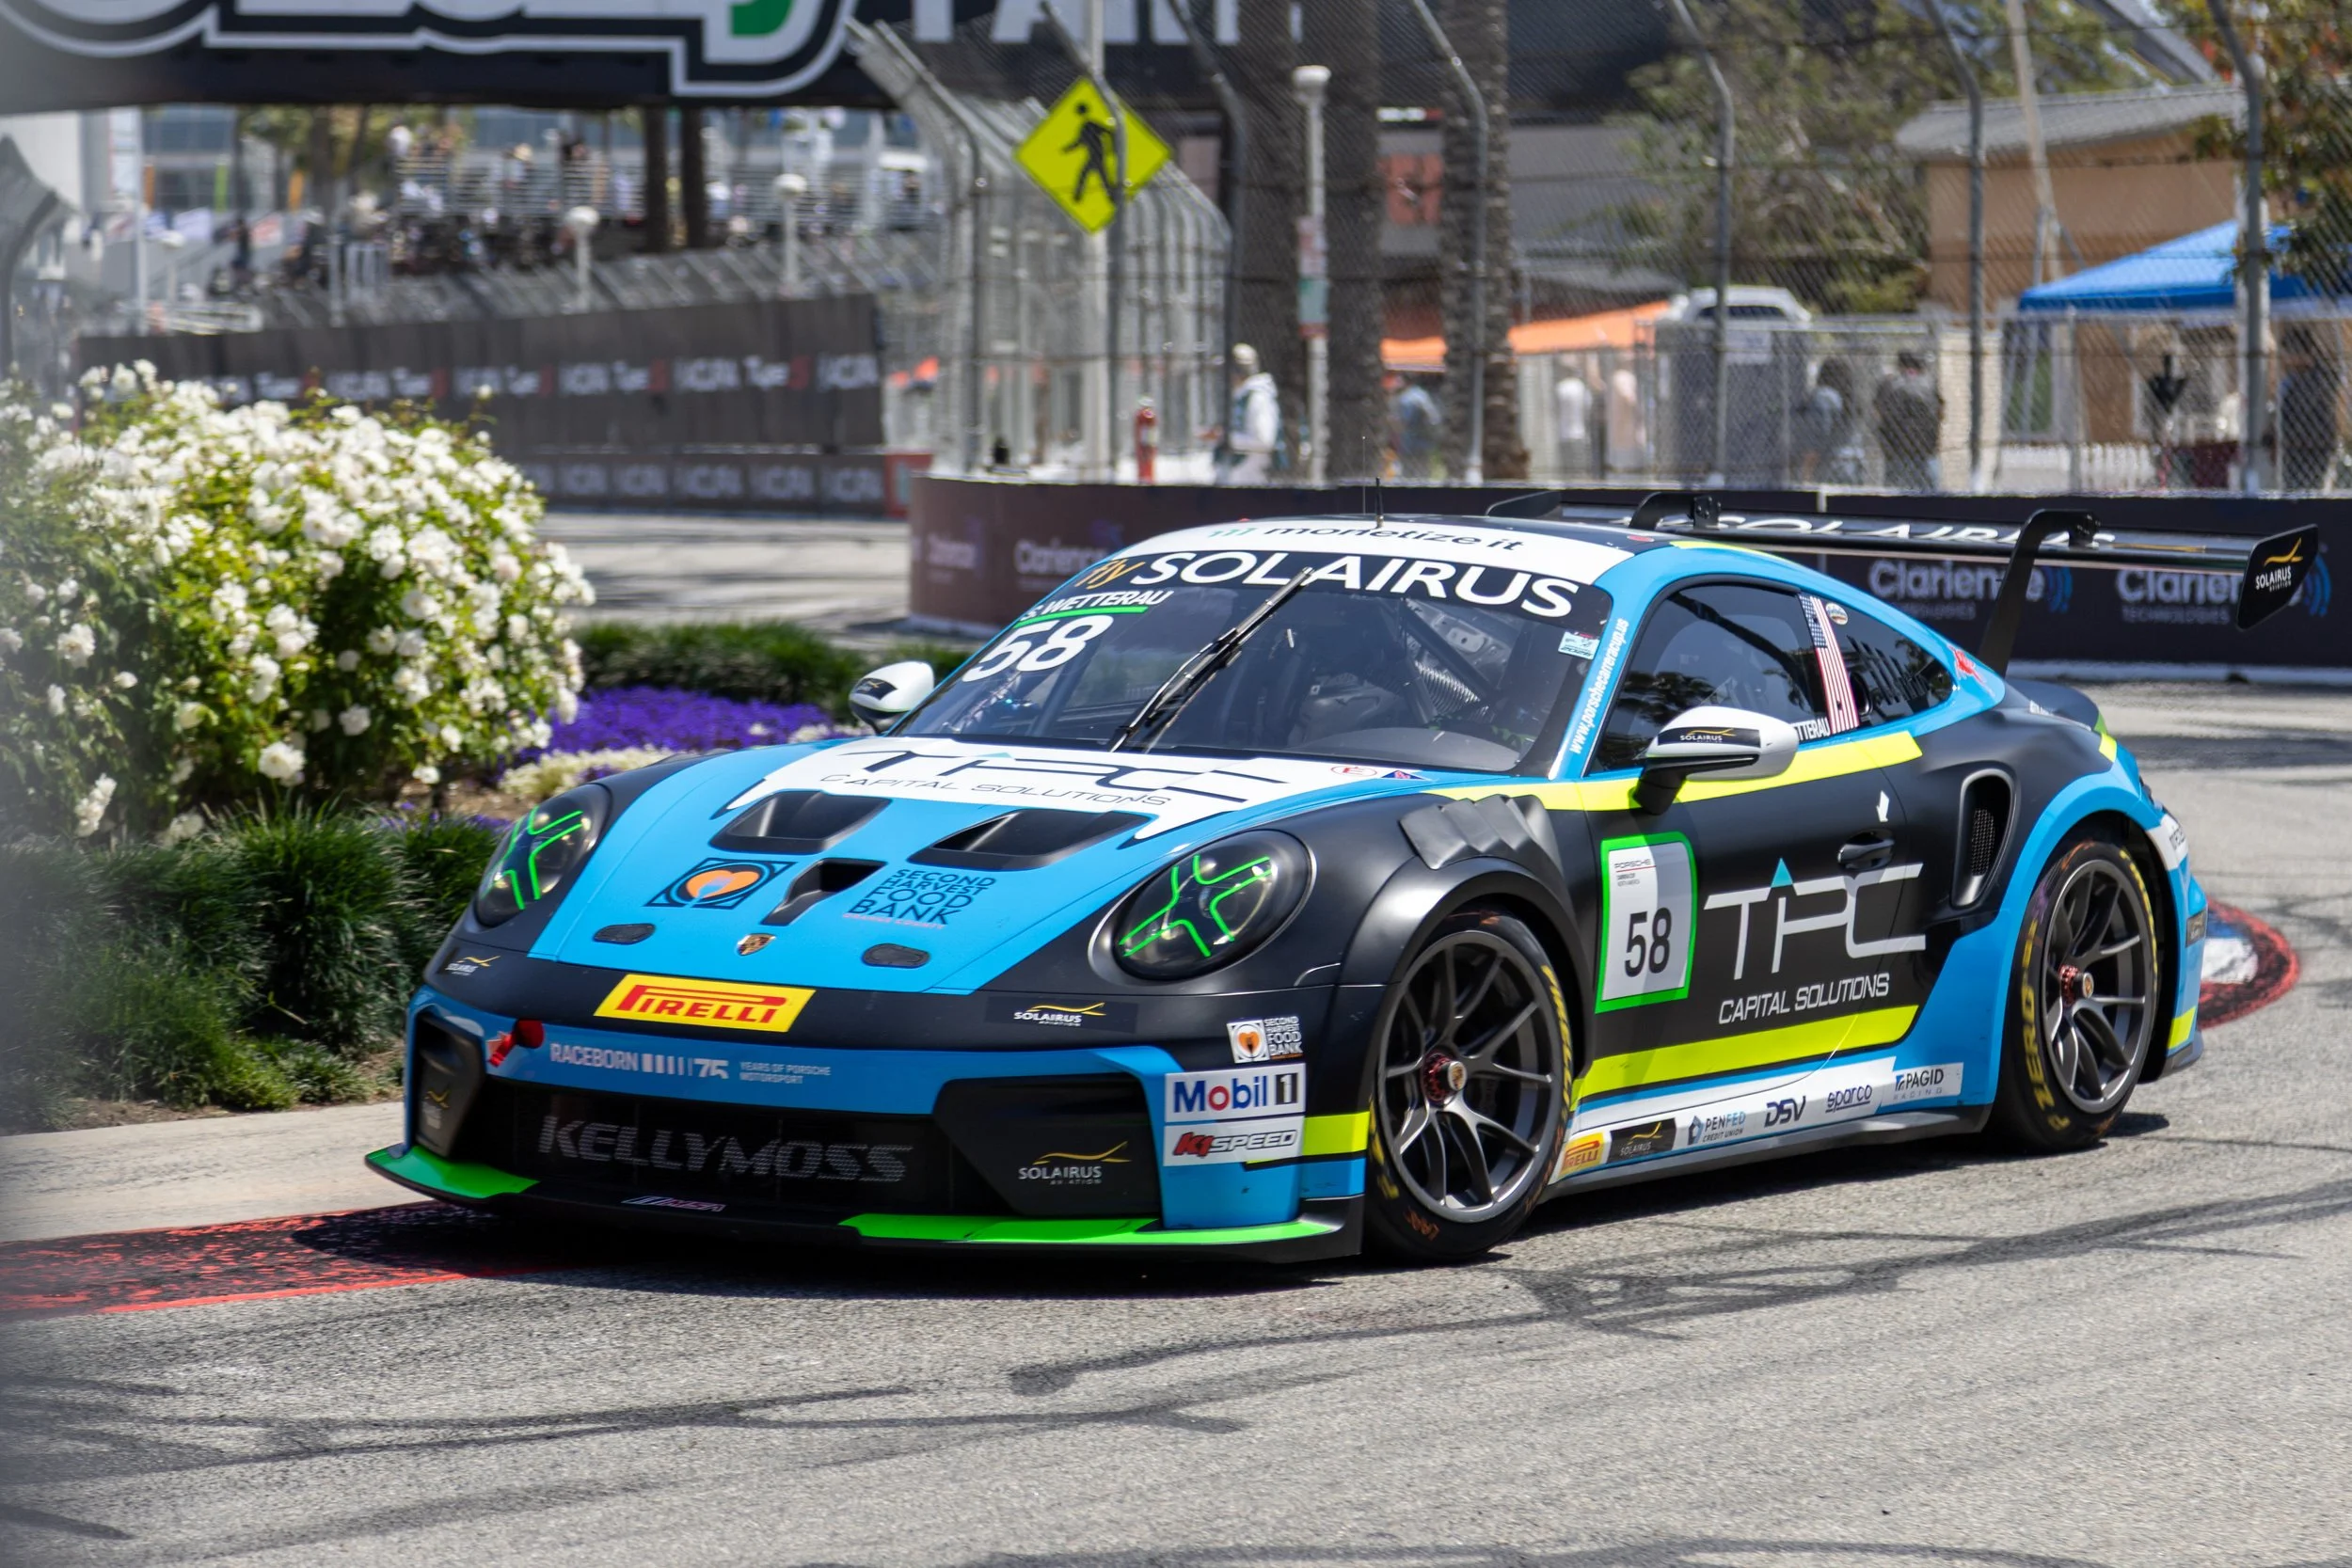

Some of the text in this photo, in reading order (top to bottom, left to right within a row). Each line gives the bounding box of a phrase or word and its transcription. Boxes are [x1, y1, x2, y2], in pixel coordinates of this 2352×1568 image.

[1264, 526, 1524, 552] monetize it
[1130, 551, 1579, 618] SOLAIRUS
[2255, 565, 2292, 590] SOLAIRUS
[1041, 590, 1175, 613] WETTERAU
[962, 614, 1114, 682] 58
[1568, 617, 1630, 755] www.porschecarreracup.us
[1679, 734, 1724, 742] SOLAIRUS
[820, 774, 1171, 806] CAPITAL SOLUTIONS
[882, 877, 990, 896] HARVEST
[894, 868, 996, 888] SECOND
[848, 899, 961, 926] BANK
[864, 887, 975, 918] FOOD
[1624, 907, 1673, 978] 58
[616, 984, 787, 1024] PIRELLI
[1718, 972, 1890, 1025] CAPITAL SOLUTIONS
[1013, 1011, 1083, 1023] SOLAIRUS
[1266, 1031, 1302, 1044] FOOD
[1268, 1041, 1304, 1055] BANK
[549, 1042, 639, 1073] RACEBORN
[693, 1057, 729, 1080] 75
[739, 1062, 832, 1076] YEARS OF PORSCHE
[1905, 1068, 1945, 1090] PAGID
[1173, 1075, 1268, 1114] Mobil
[1825, 1084, 1873, 1114] sparco
[1893, 1085, 1944, 1101] RACING
[1705, 1110, 1746, 1131] PENFED
[1764, 1095, 1807, 1128] DSV
[1703, 1128, 1744, 1143] CREDIT UNION
[537, 1115, 914, 1182] KELLYMOSS
[1017, 1165, 1103, 1180] SOLAIRUS
